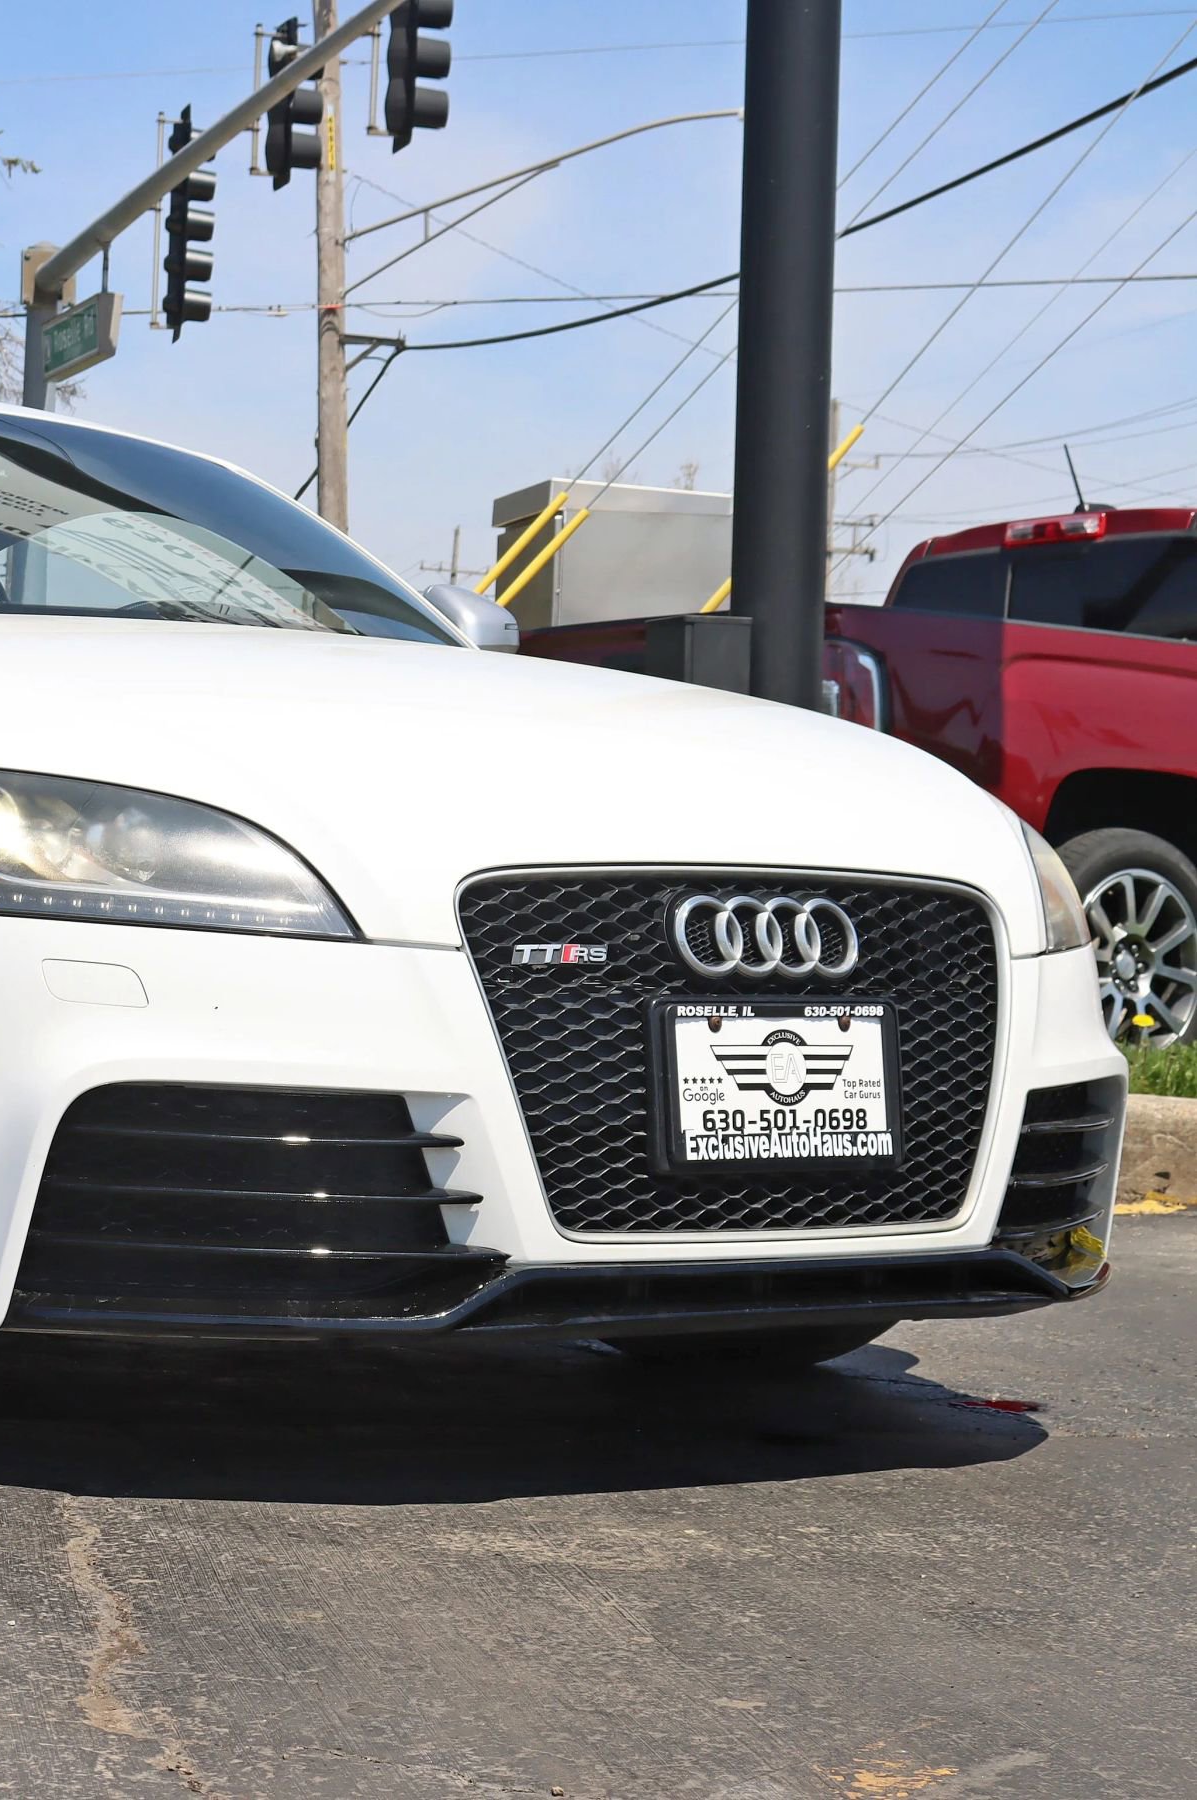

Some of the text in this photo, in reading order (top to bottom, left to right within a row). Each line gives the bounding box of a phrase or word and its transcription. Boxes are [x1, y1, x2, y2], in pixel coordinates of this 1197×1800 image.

[677, 1005, 755, 1018] ROSELLE, IL
[804, 1005, 884, 1017] 630-501-0698
[767, 1031, 801, 1045] EXCLUSIVE
[842, 1078, 881, 1089] Top Rated
[683, 1088, 725, 1105] Google
[770, 1090, 806, 1104] AUTOHAUS
[844, 1090, 881, 1099] Car Gurus
[702, 1108, 868, 1132] 630-501-0698
[687, 1127, 893, 1160] ExclusiveAutoHaus.com
